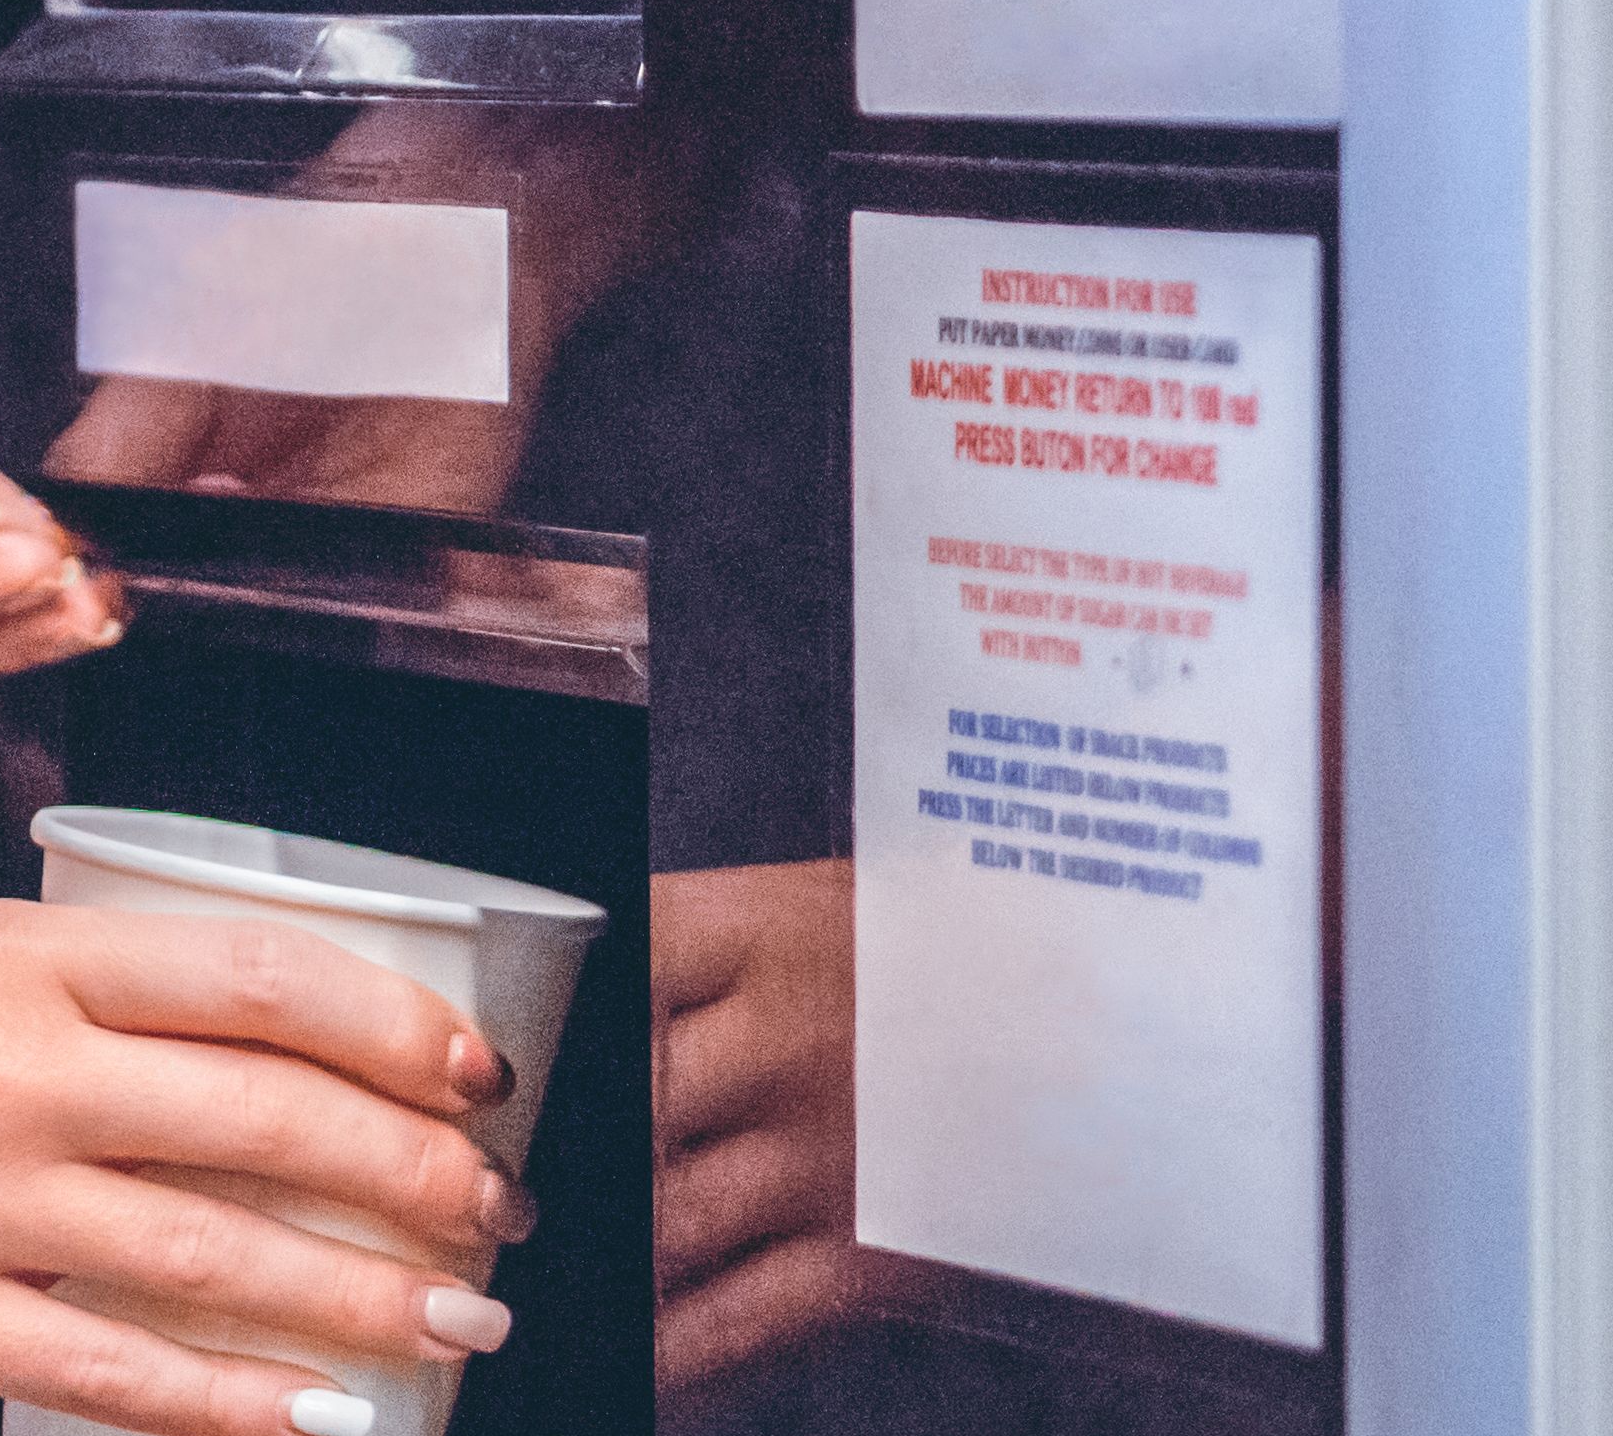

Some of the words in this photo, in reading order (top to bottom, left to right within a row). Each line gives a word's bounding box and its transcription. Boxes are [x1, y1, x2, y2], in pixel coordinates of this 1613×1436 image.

[981, 269, 1109, 308] INSTRUCTION
[1115, 278, 1153, 312] FOR
[939, 318, 967, 343] PUT
[972, 320, 1019, 347] PAPER
[910, 359, 992, 403] MACHINE
[1002, 368, 1069, 409] MONEY
[1075, 372, 1153, 416] RETURN
[955, 421, 1016, 465] PRESS
[1091, 433, 1130, 475] FOR
[1134, 439, 1218, 485] CHANGE
